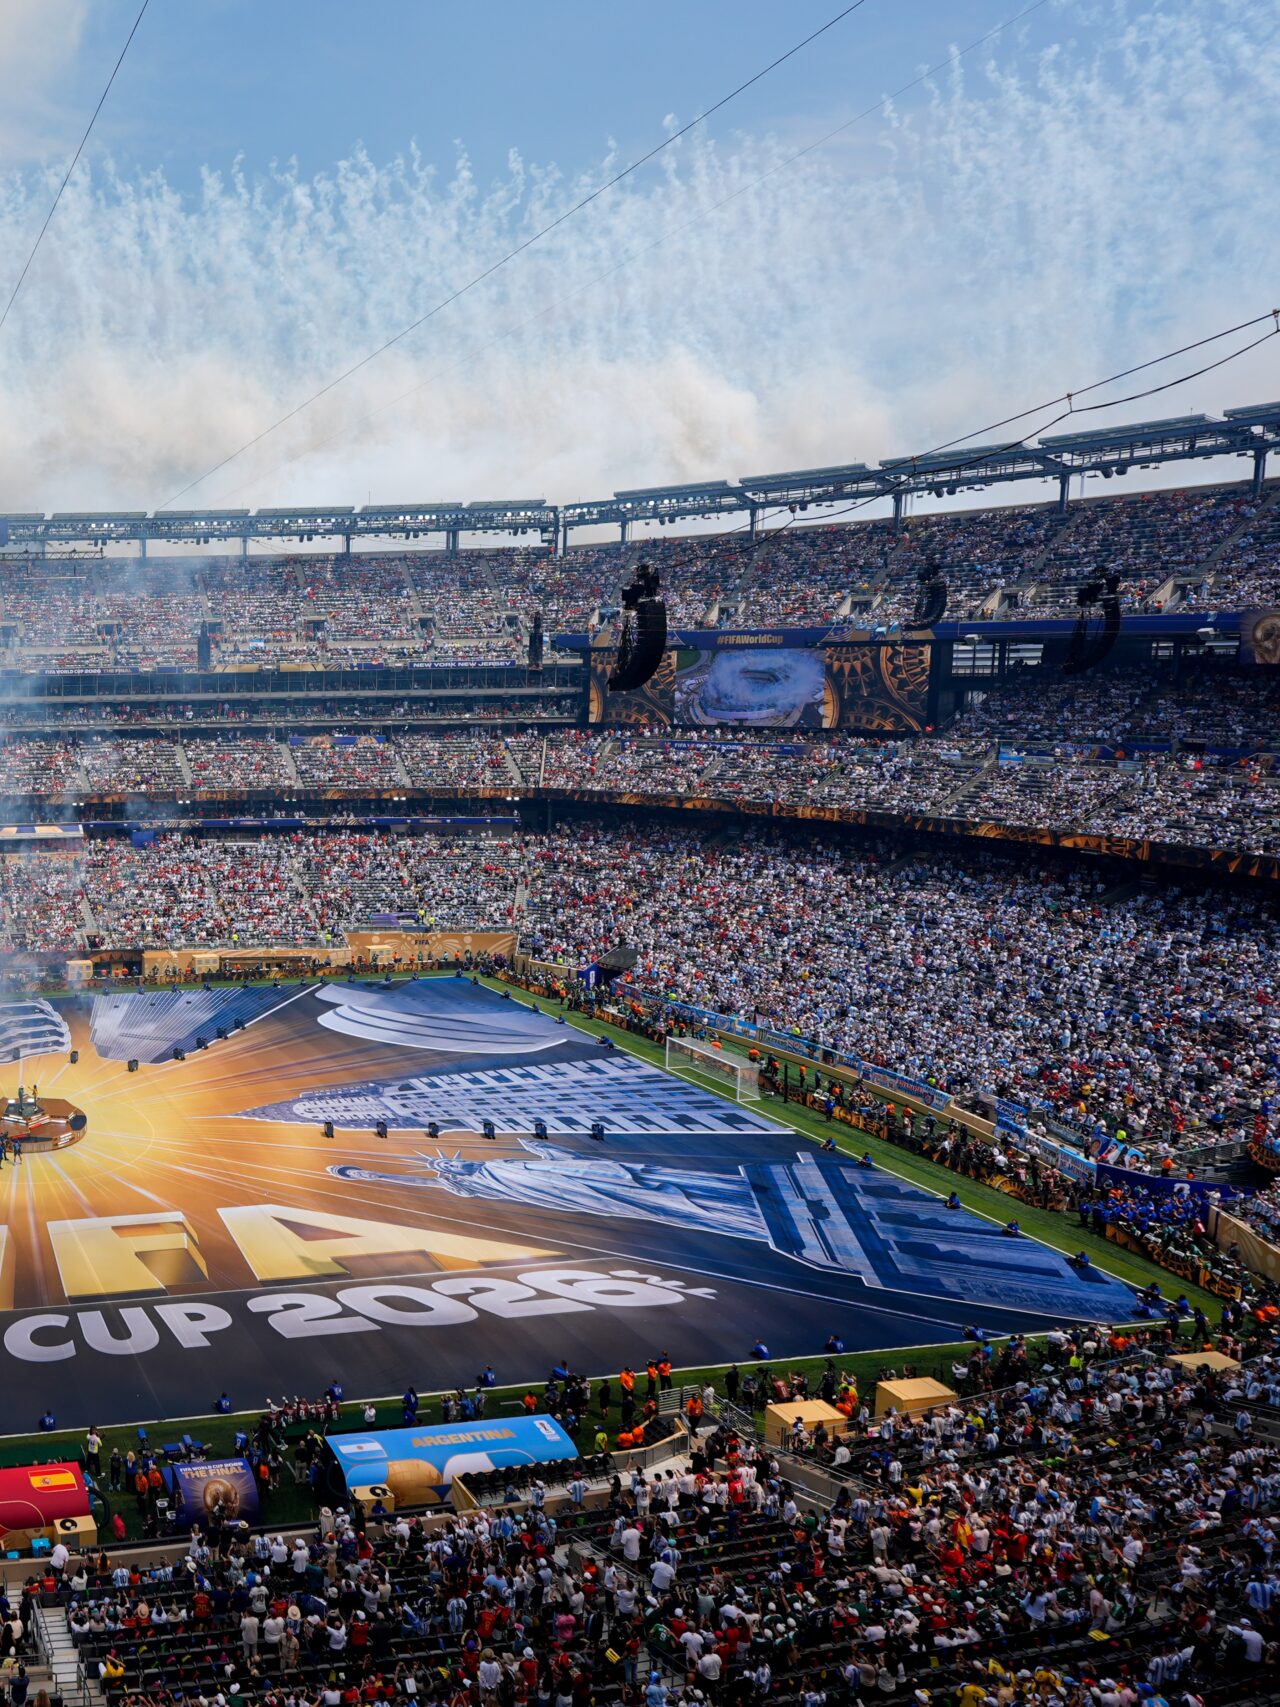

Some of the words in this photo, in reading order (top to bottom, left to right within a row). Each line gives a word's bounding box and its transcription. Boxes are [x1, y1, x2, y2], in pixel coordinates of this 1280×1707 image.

[717, 633, 784, 645] #FIFAWorldCup
[3, 1302, 233, 1363] CUP
[246, 1269, 686, 1340] 2026
[411, 1428, 518, 1448] ARGENTINA
[182, 1470, 207, 1479] THE
[209, 1466, 247, 1477] FINAL
